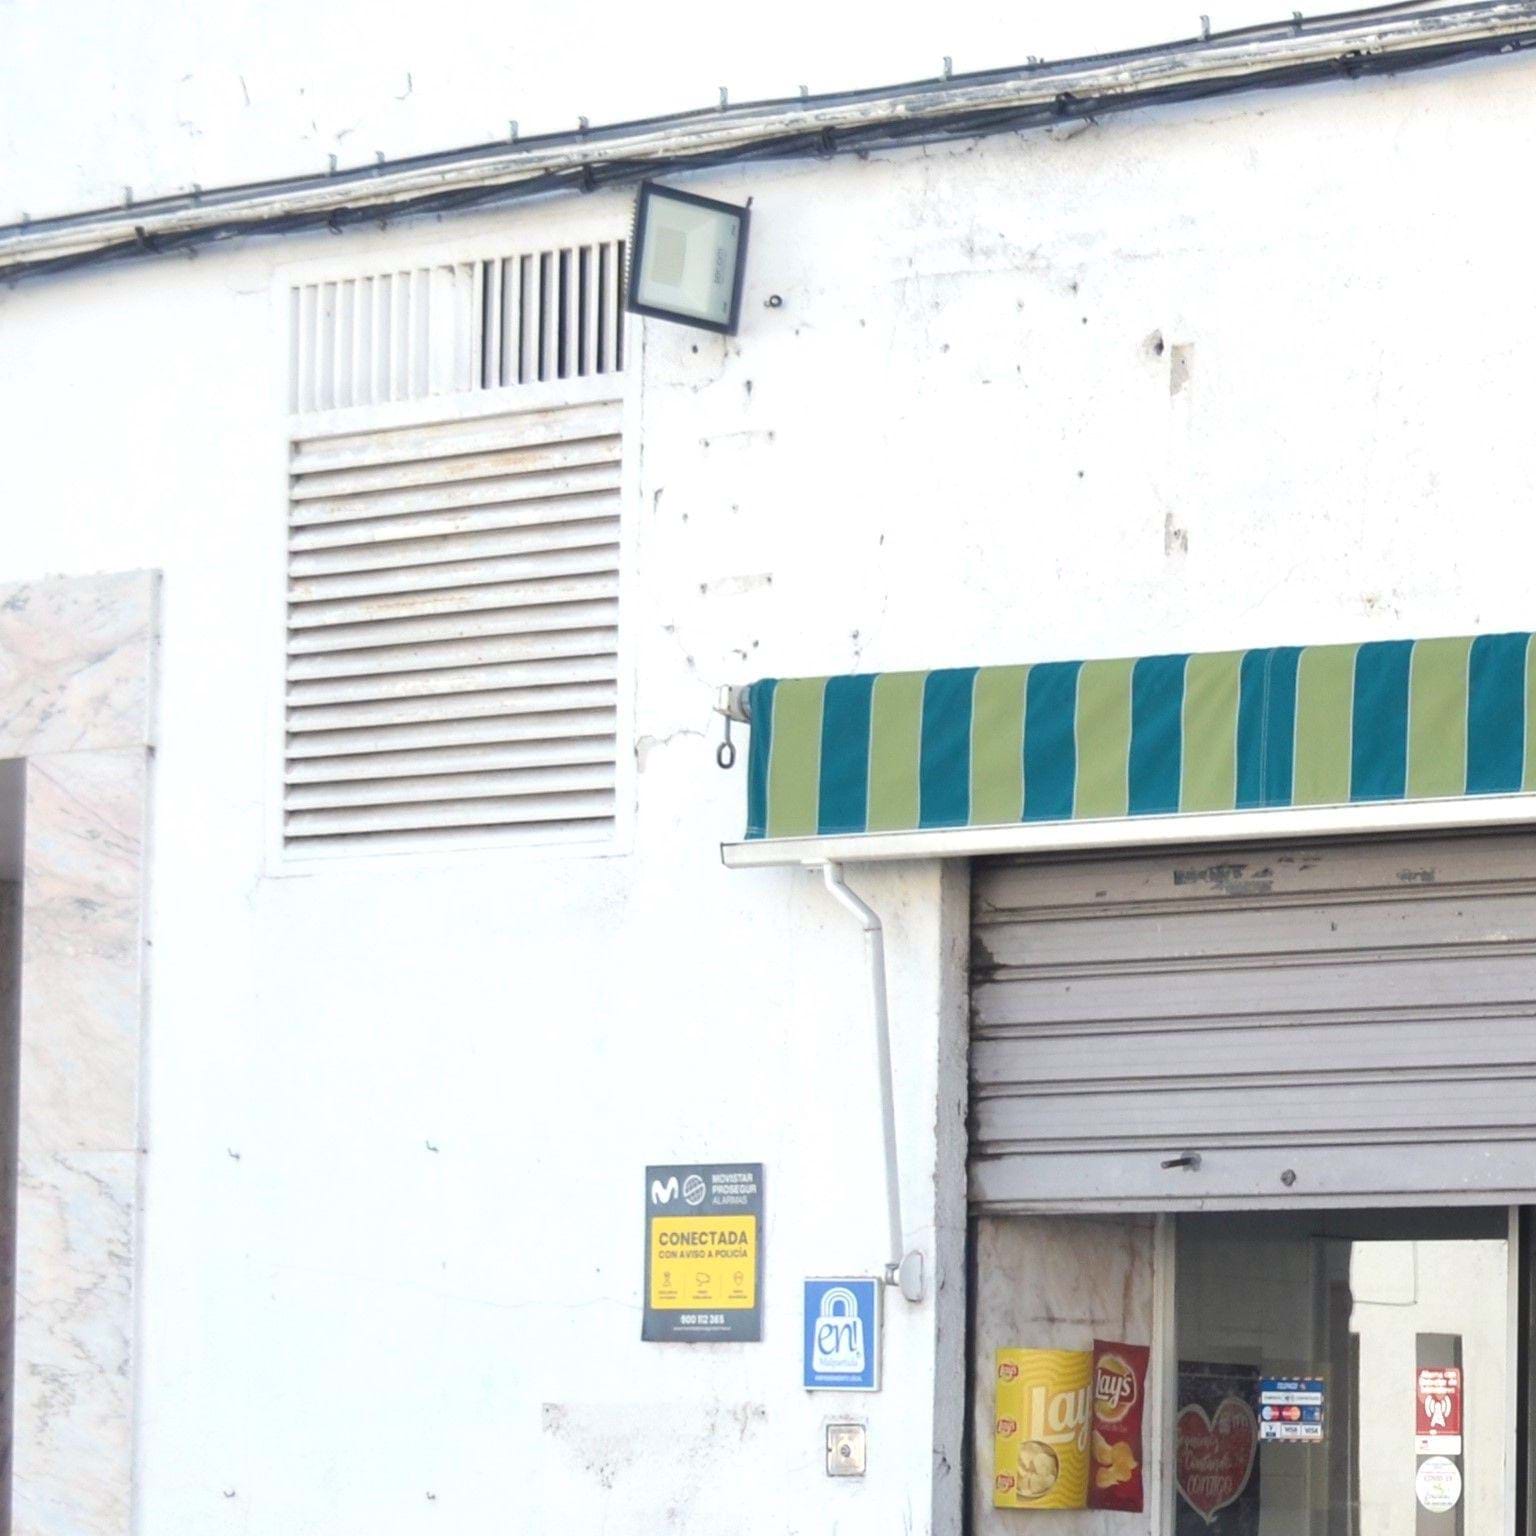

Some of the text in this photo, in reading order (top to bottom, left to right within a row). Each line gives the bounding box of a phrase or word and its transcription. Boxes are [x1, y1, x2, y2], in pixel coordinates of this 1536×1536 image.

[658, 1230, 749, 1246] CONECTADA
[658, 1250, 679, 1259] CON
[707, 1249, 714, 1258] A
